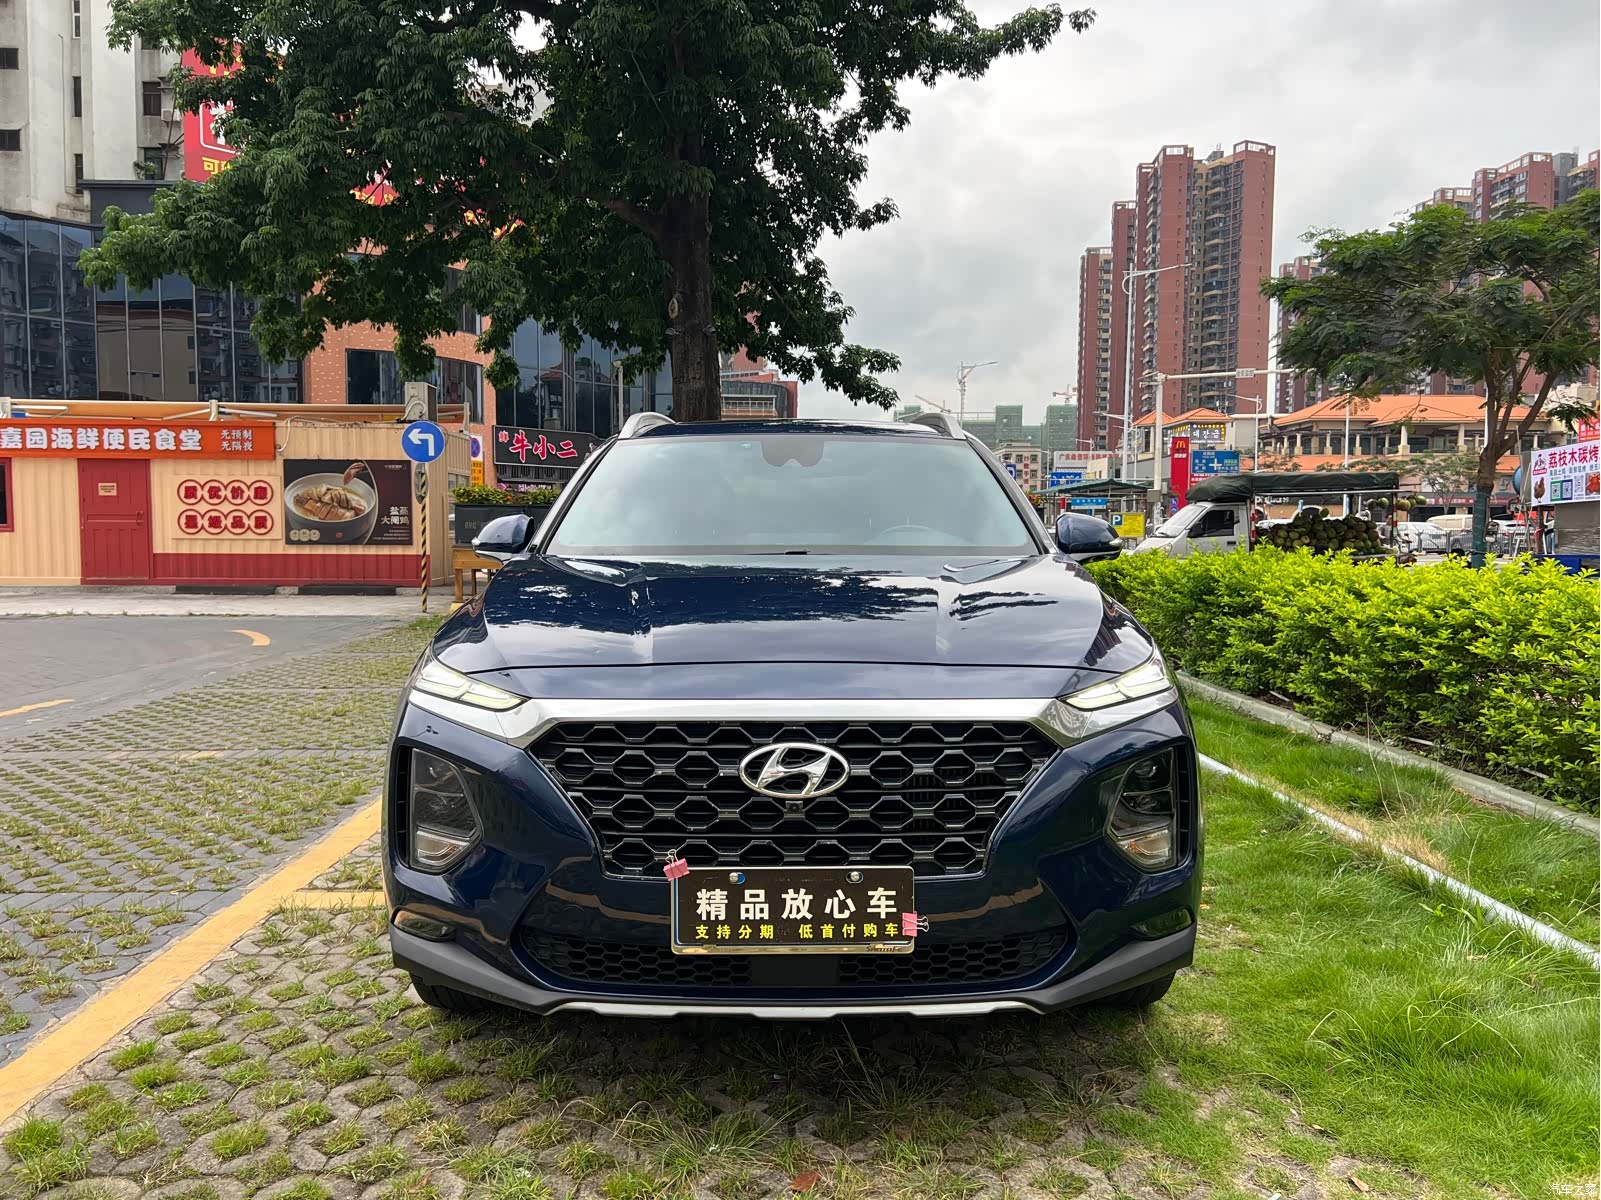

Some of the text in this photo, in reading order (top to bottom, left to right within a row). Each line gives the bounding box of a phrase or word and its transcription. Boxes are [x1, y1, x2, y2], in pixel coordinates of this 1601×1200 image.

[0, 427, 202, 451] 嘉园海鲜便民食堂
[220, 429, 252, 440] 无预制
[509, 430, 578, 463] 牛小二
[183, 485, 268, 500] 质优价廉
[184, 514, 268, 530] 星级品质
[1112, 515, 1121, 525] P
[696, 887, 898, 921] 精品放心车
[695, 922, 899, 939] 支持分期 低首付购车
